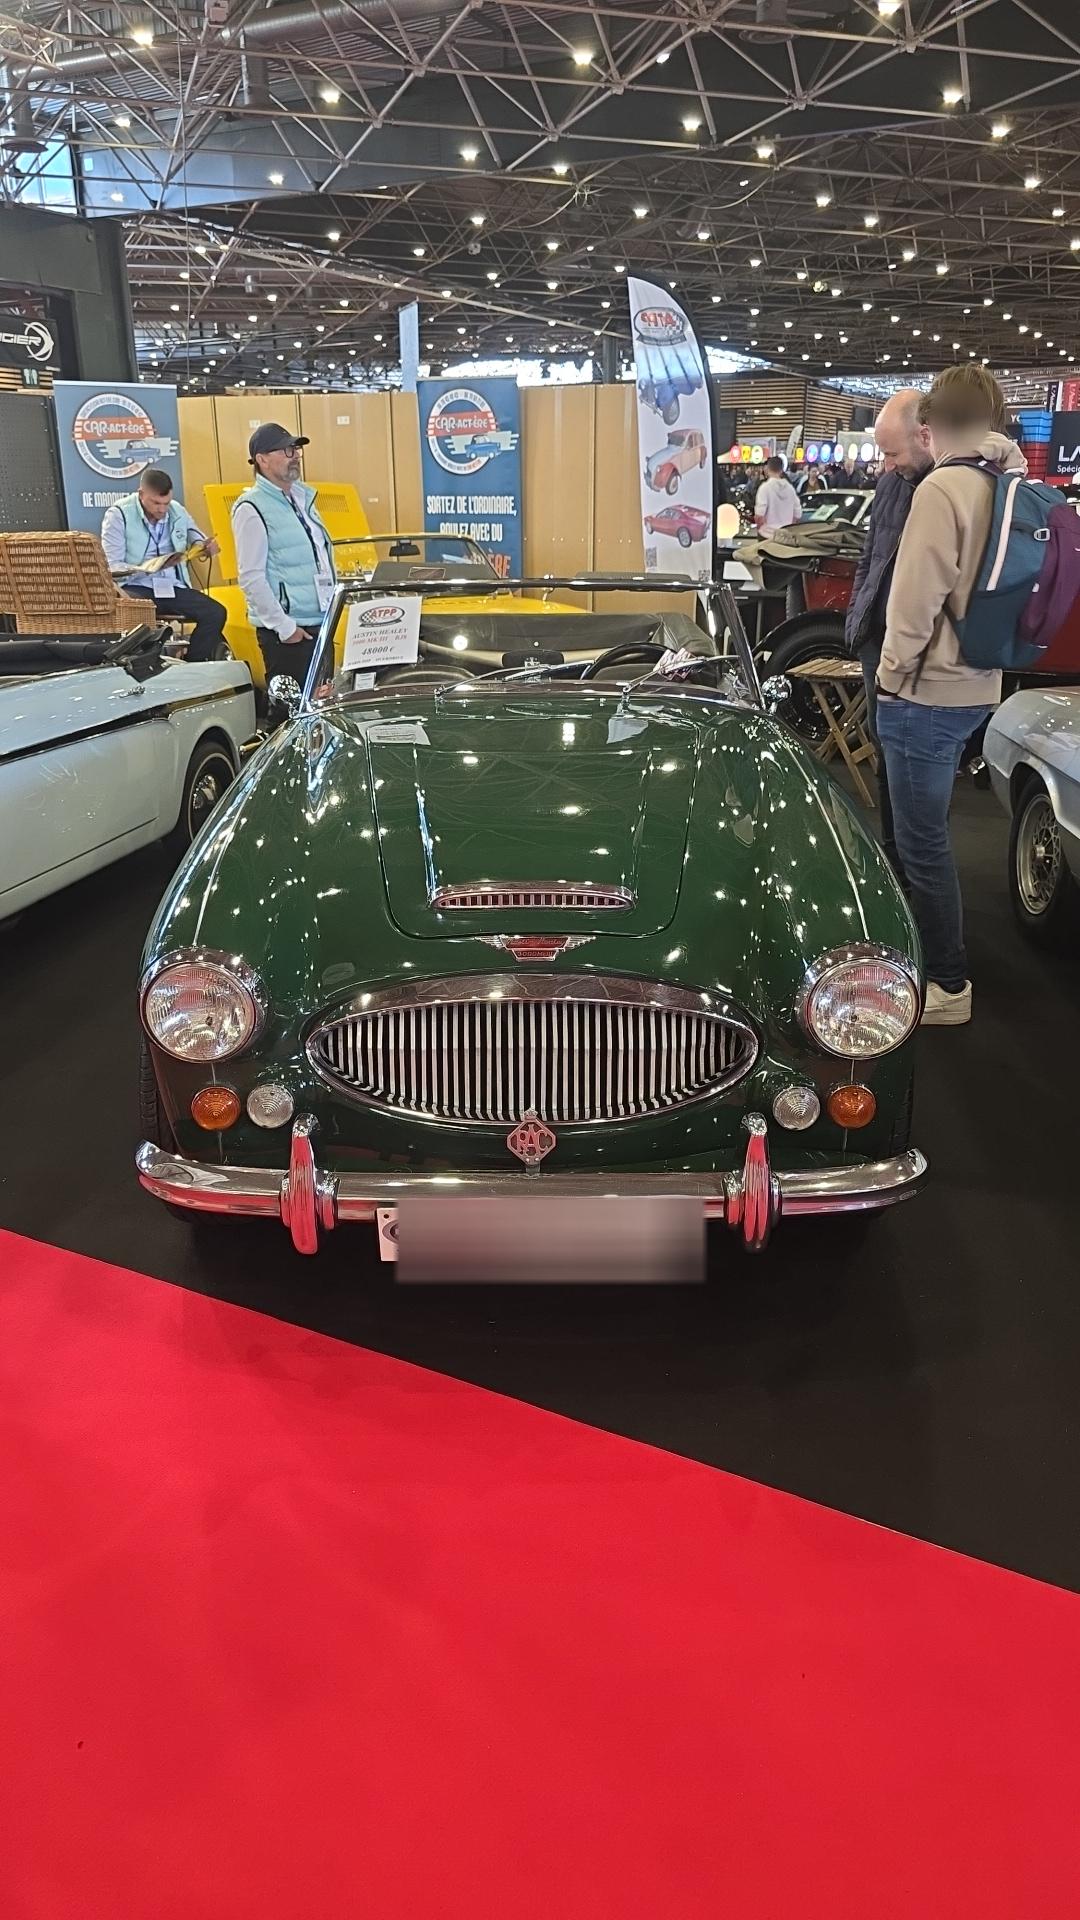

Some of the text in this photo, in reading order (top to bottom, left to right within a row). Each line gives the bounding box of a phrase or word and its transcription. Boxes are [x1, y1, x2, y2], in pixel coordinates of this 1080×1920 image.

[82, 491, 93, 508] NE
[426, 495, 518, 517] SORTEZ DE L'ORDINAIRE,
[440, 522, 503, 542] ROULEZ AVEC DU
[369, 608, 397, 619] ATPP
[352, 627, 409, 640] AUSTIN HEALEY
[361, 646, 389, 656] 48000
[516, 1123, 549, 1158] RAC
